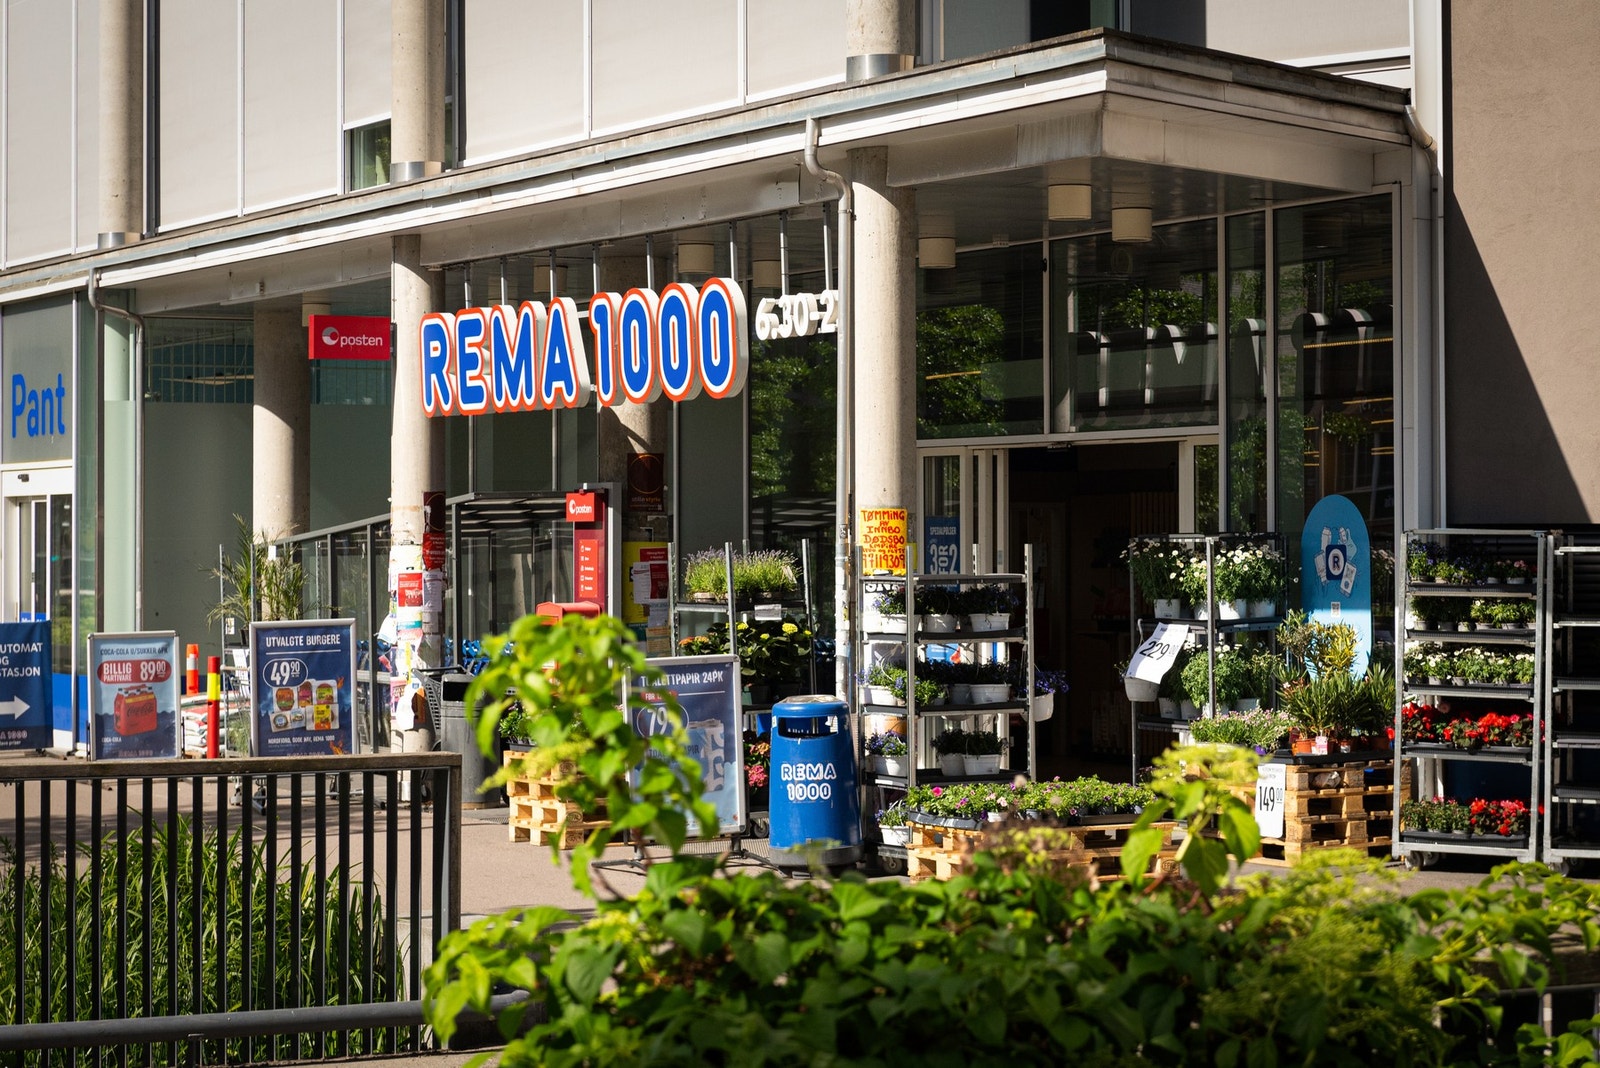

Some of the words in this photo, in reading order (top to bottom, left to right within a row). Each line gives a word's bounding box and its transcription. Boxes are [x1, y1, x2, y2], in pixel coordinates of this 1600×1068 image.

[755, 289, 838, 340] 6.30-2
[340, 334, 383, 347] posten
[420, 297, 580, 418] REMA
[589, 277, 740, 407] 1000
[12, 372, 65, 438] Pant
[575, 505, 592, 515] posten
[863, 534, 905, 545] DØDSBO
[930, 543, 938, 575] 3
[938, 545, 949, 575] FOR
[949, 543, 958, 575] 2
[266, 635, 304, 647] UTVALGTE
[306, 633, 341, 645] BURGERE
[0, 643, 43, 653] UTOMAT
[103, 662, 132, 675] BILLIG
[103, 674, 132, 682] PARTIVARE
[702, 669, 724, 684] 24PK
[781, 762, 837, 781] REMA
[786, 783, 831, 801] 1000
